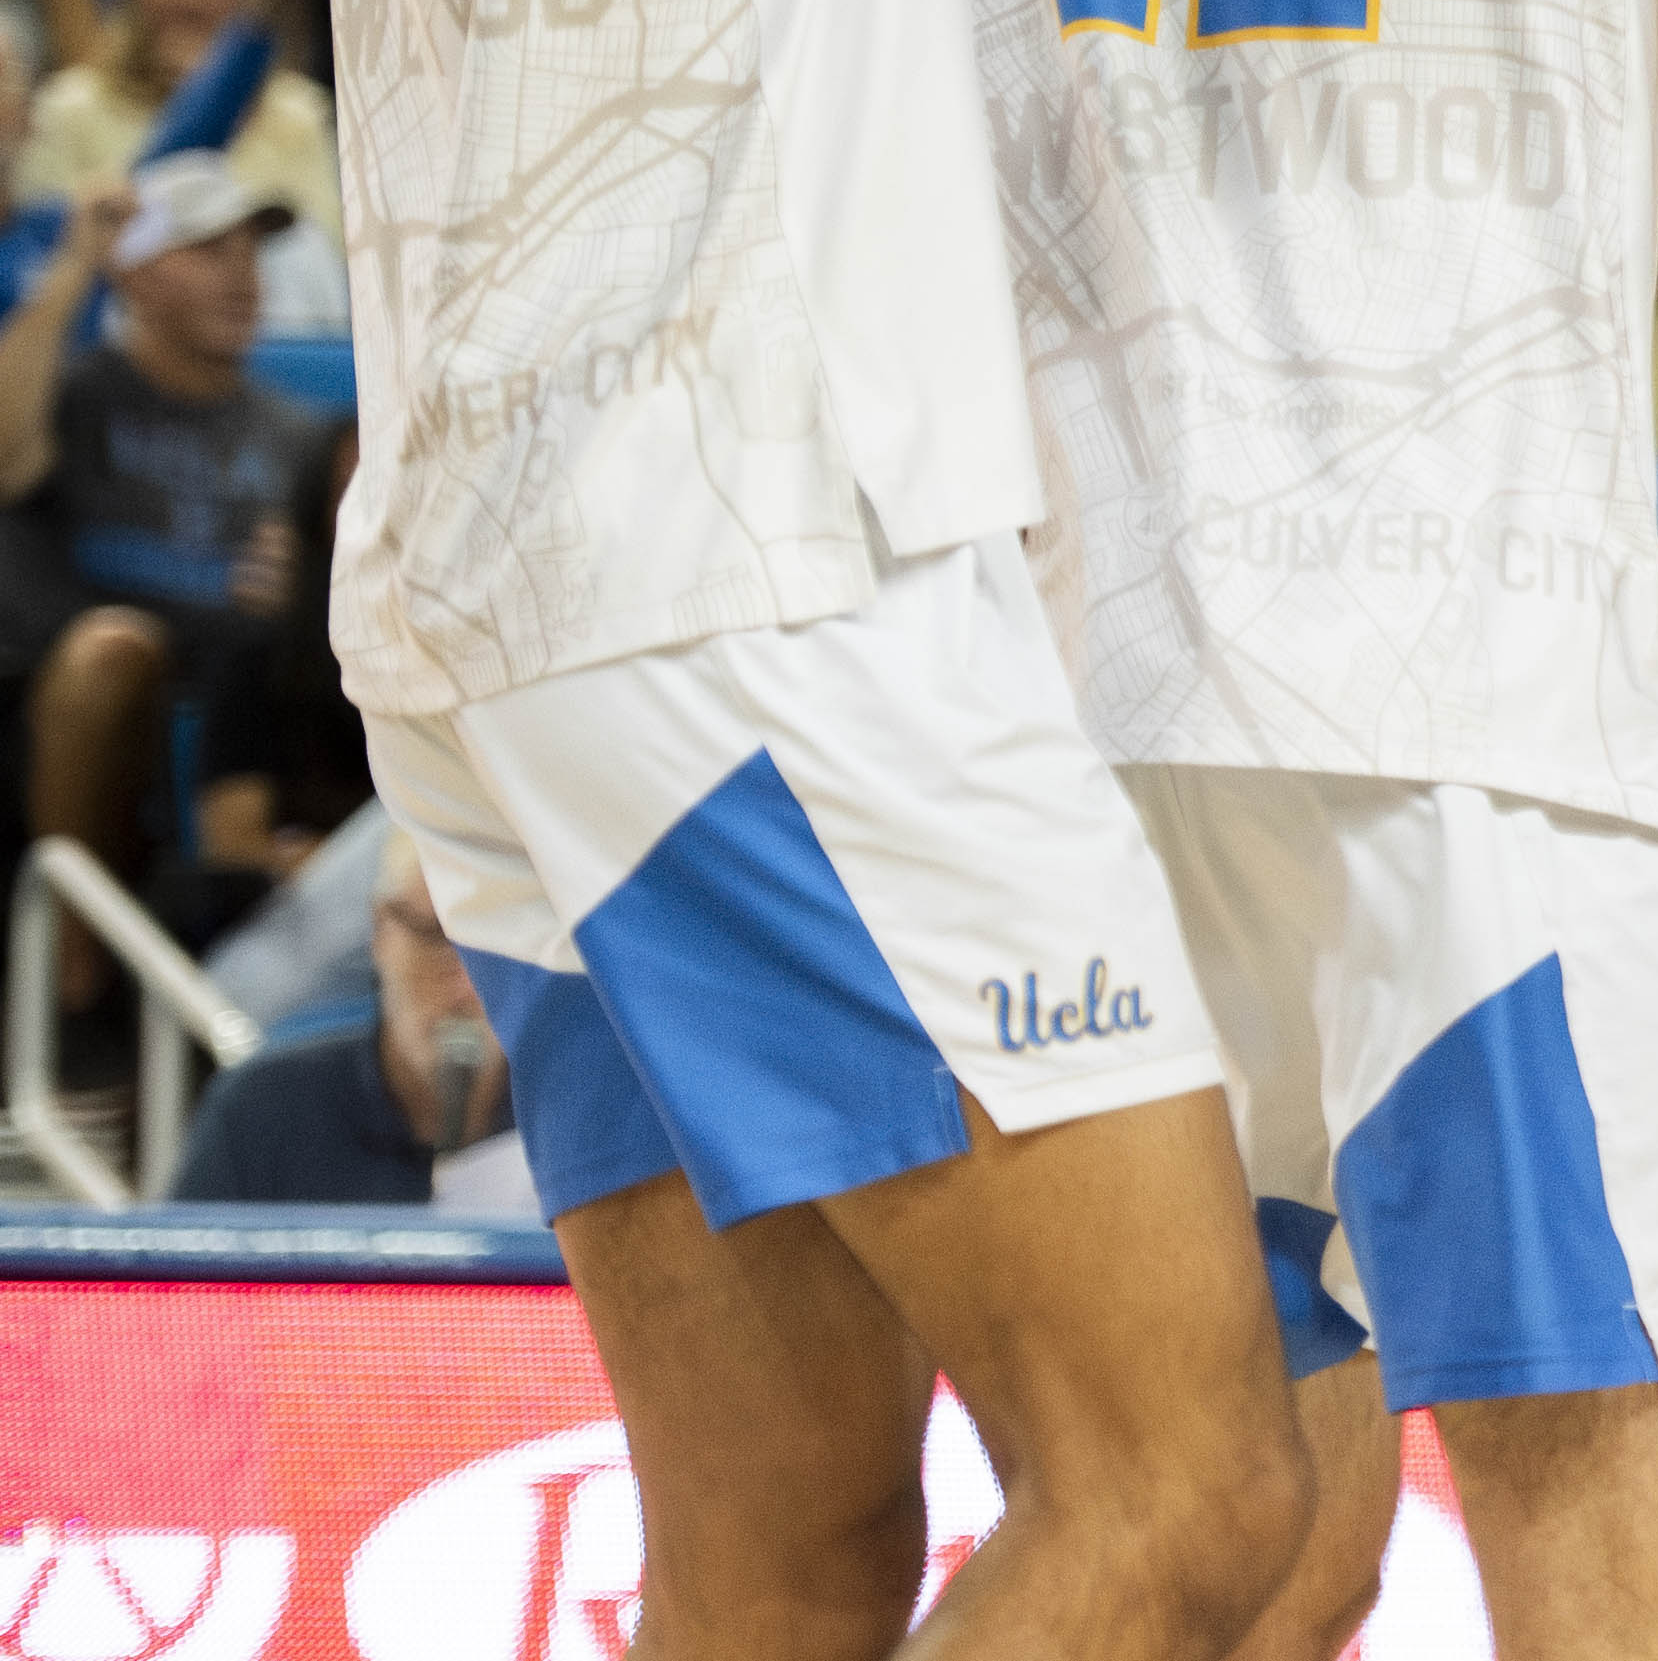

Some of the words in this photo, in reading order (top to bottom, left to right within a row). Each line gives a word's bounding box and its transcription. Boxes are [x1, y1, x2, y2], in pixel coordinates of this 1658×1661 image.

[985, 72, 1568, 208] WSTWOOD
[1193, 494, 1460, 577] CULVER
[1493, 523, 1635, 607] CITY
[979, 956, 1155, 1054] Ucla
